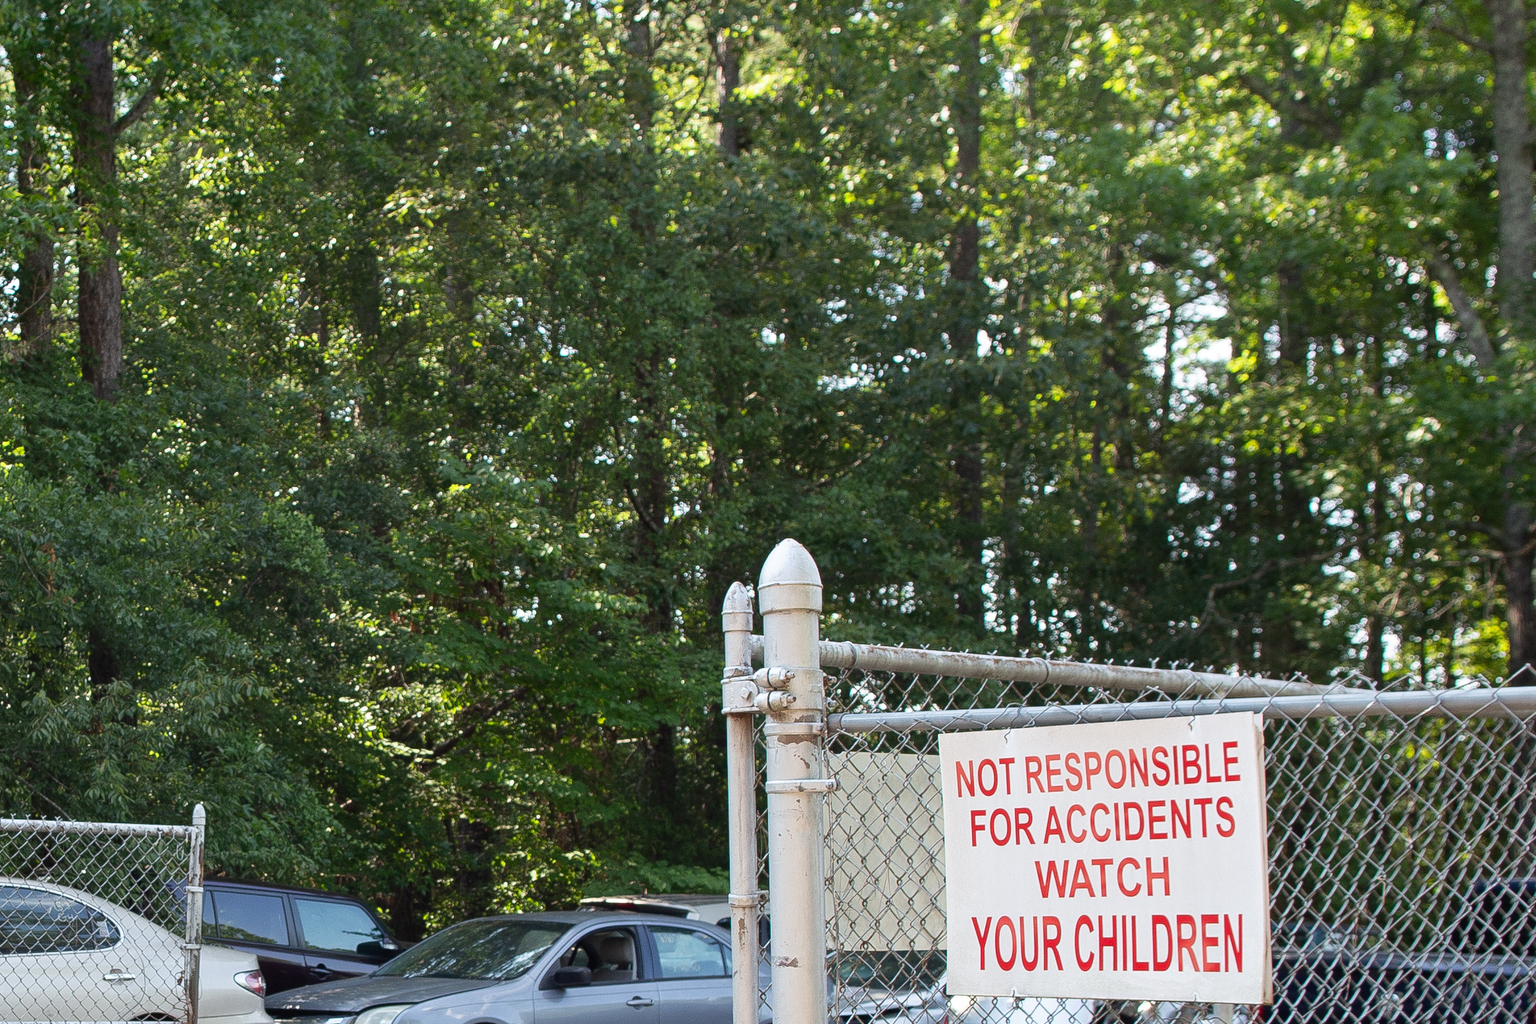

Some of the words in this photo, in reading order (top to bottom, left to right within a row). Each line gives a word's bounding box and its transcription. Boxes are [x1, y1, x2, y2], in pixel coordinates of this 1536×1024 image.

[955, 758, 1015, 798] NOT
[1025, 741, 1240, 794] RESPONSIBLE
[970, 807, 1035, 847] FOR
[1043, 796, 1235, 844] ACCIDENTS
[1035, 857, 1170, 898] WATCH
[971, 916, 1063, 971] YOUR
[1074, 914, 1243, 973] CHILDREN
